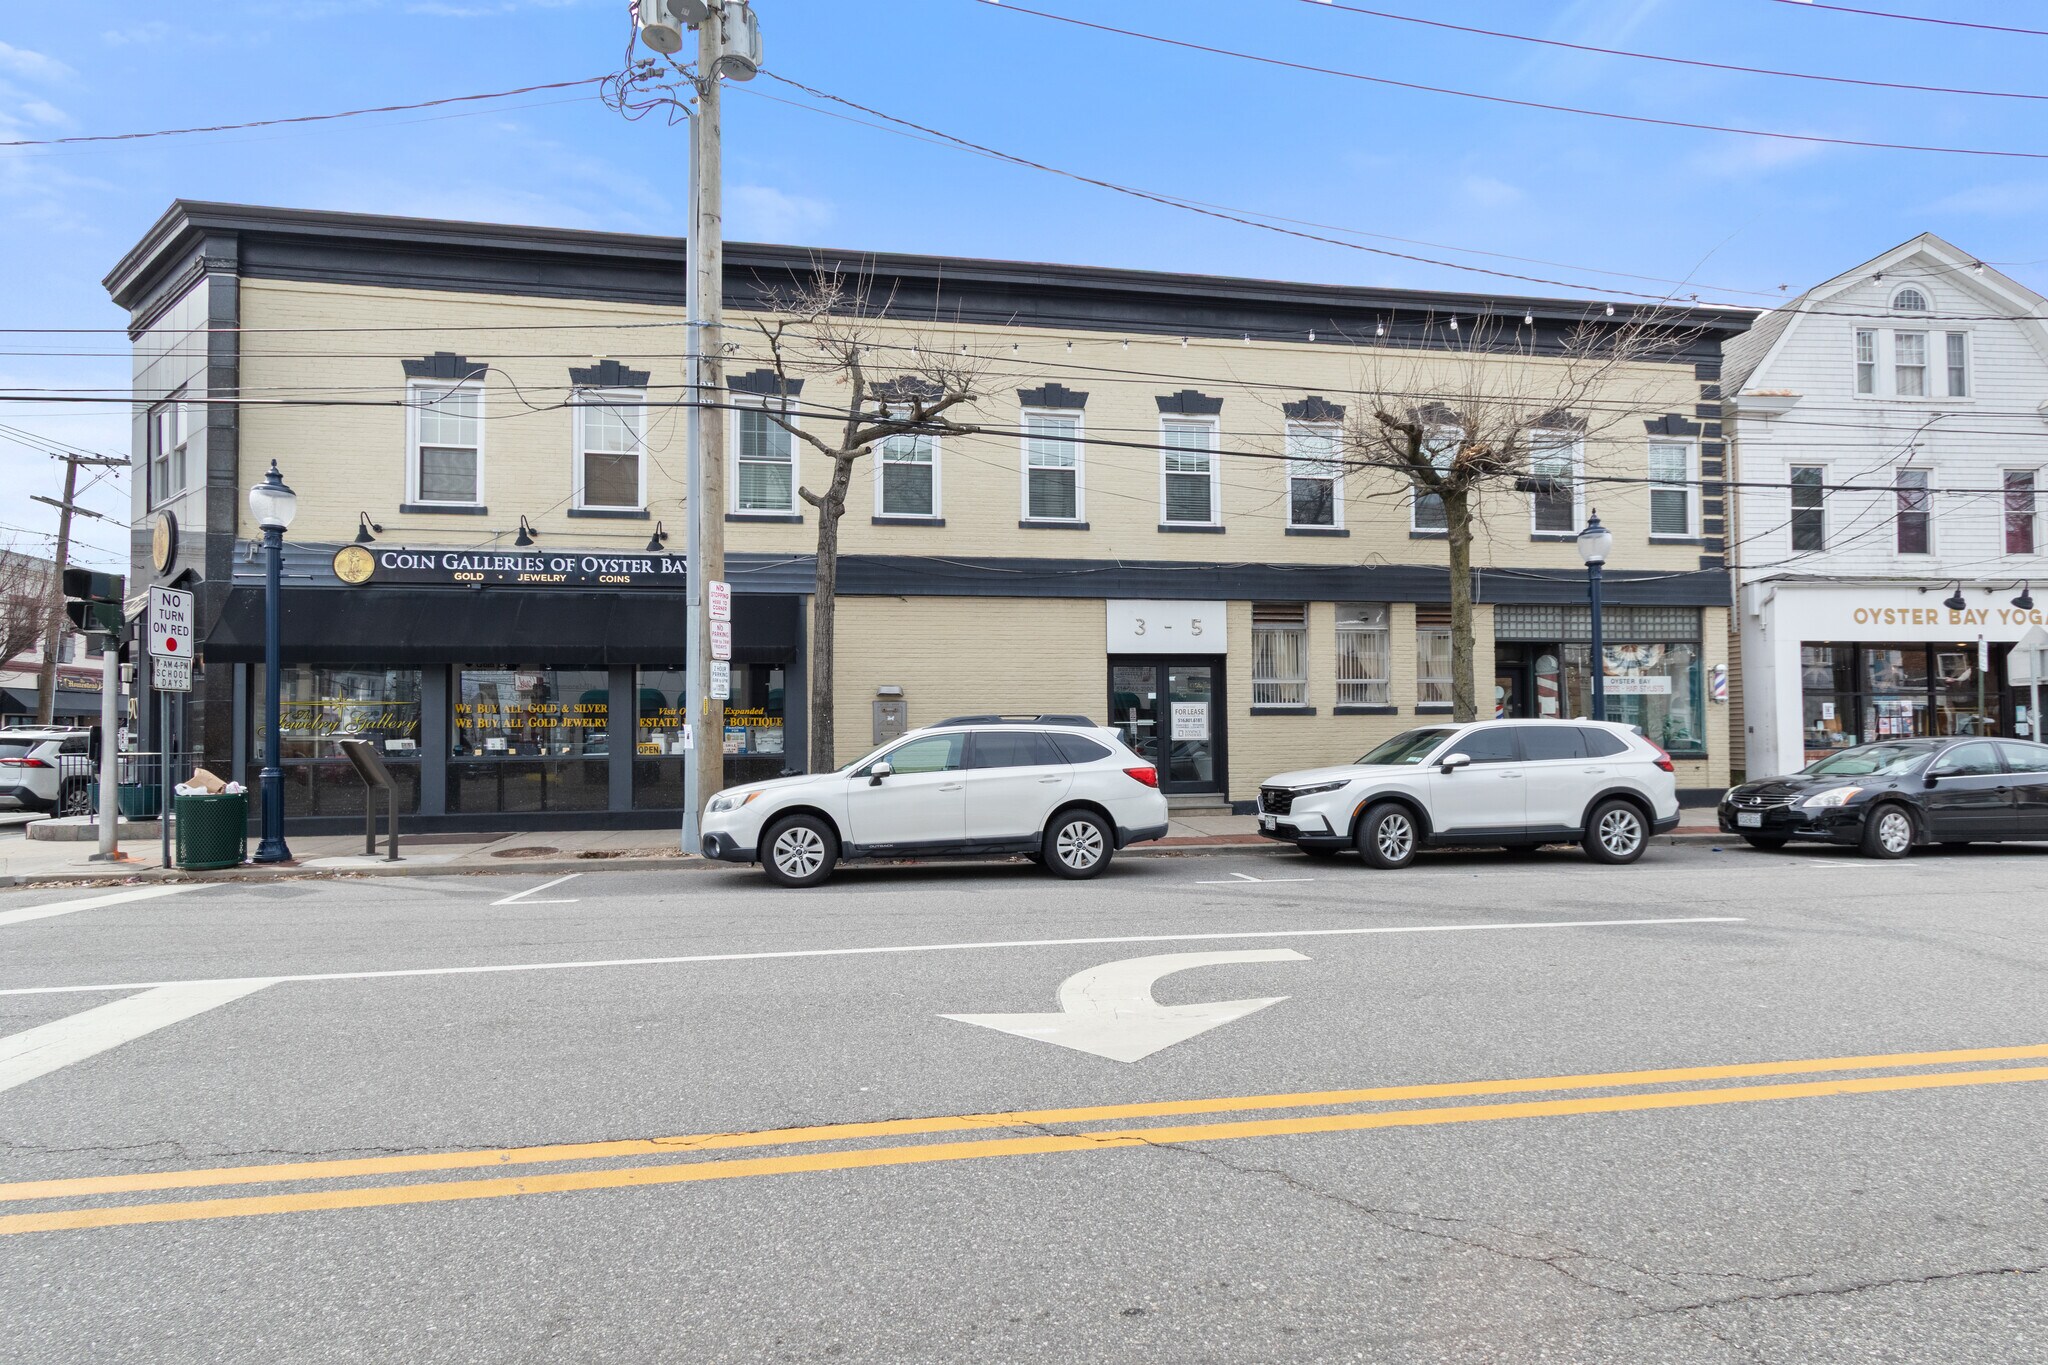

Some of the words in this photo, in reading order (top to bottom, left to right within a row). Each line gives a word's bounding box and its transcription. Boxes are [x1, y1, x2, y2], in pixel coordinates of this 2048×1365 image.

[381, 552, 436, 570] COIN
[442, 553, 544, 572] GALLERIES
[552, 557, 576, 572] OF
[581, 556, 654, 574] OYSTER
[454, 571, 484, 581] GOLD
[518, 573, 567, 583] JEWELRY
[599, 574, 630, 584] COINS
[162, 593, 181, 608] NO
[159, 609, 184, 622] TURN
[1854, 608, 1939, 625] OYSTER
[1949, 608, 1989, 625] BAY
[1997, 608, 2048, 625] YOG
[153, 622, 166, 633] ON
[171, 625, 189, 636] RED
[1134, 618, 1146, 636] 3
[1191, 618, 1203, 636] 5
[156, 669, 188, 679] SCHOOL
[68, 680, 98, 689] Homestead
[162, 679, 183, 688] DAYS
[455, 704, 472, 714] WE
[477, 704, 499, 714] BUY
[503, 704, 523, 713] ALL
[528, 703, 557, 713] GOLD
[561, 704, 569, 713] &
[574, 704, 608, 713] SILVER
[724, 708, 764, 716] Expanded
[345, 710, 419, 736] Gallery
[455, 718, 472, 728] WE
[477, 718, 499, 728] BUY
[503, 718, 523, 728] ALL
[528, 718, 557, 728] GOLD
[562, 718, 608, 728] JEWELRY
[640, 718, 678, 727] ESTATE
[730, 717, 783, 728] BOUTIQUE
[638, 744, 659, 754] OPEN
